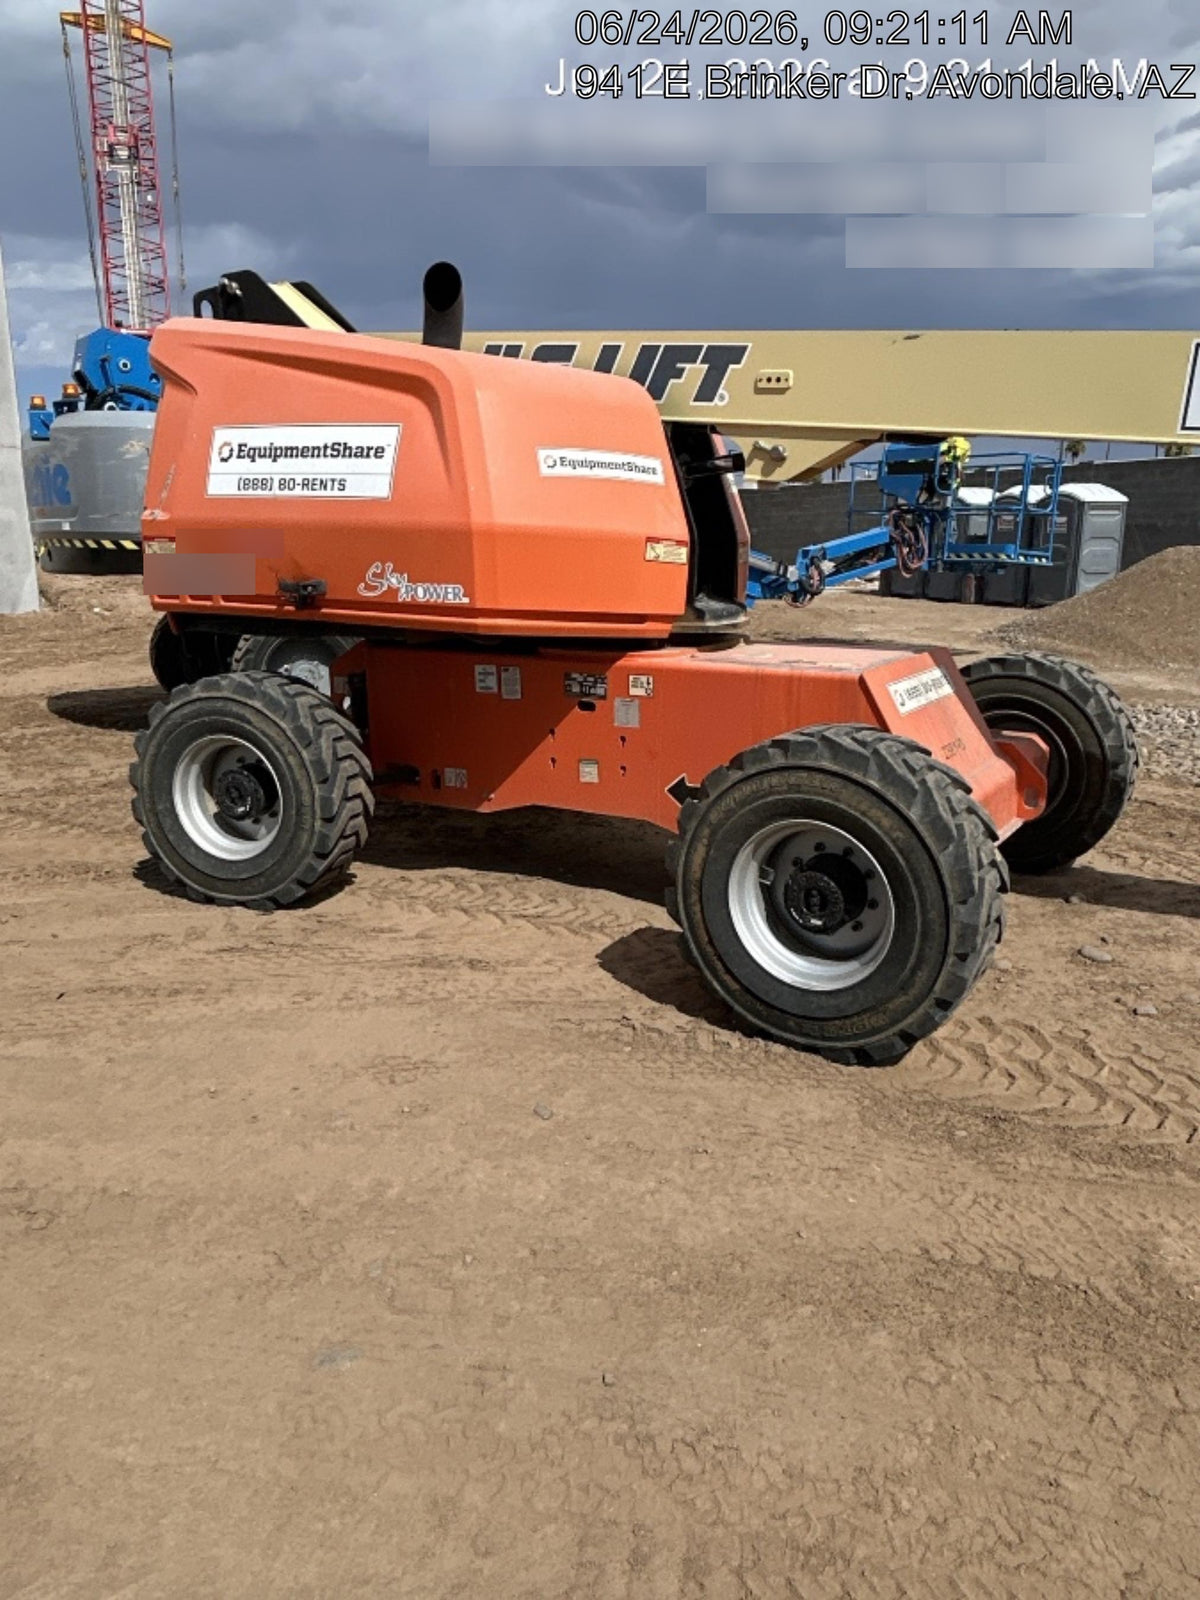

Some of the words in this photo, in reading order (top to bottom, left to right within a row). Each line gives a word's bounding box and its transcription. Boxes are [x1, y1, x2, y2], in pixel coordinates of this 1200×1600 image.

[235, 442, 386, 463] EquipmentShare
[559, 455, 659, 476] EquipmentShare
[236, 476, 274, 492] (888)
[278, 476, 348, 492] 80-RENTS
